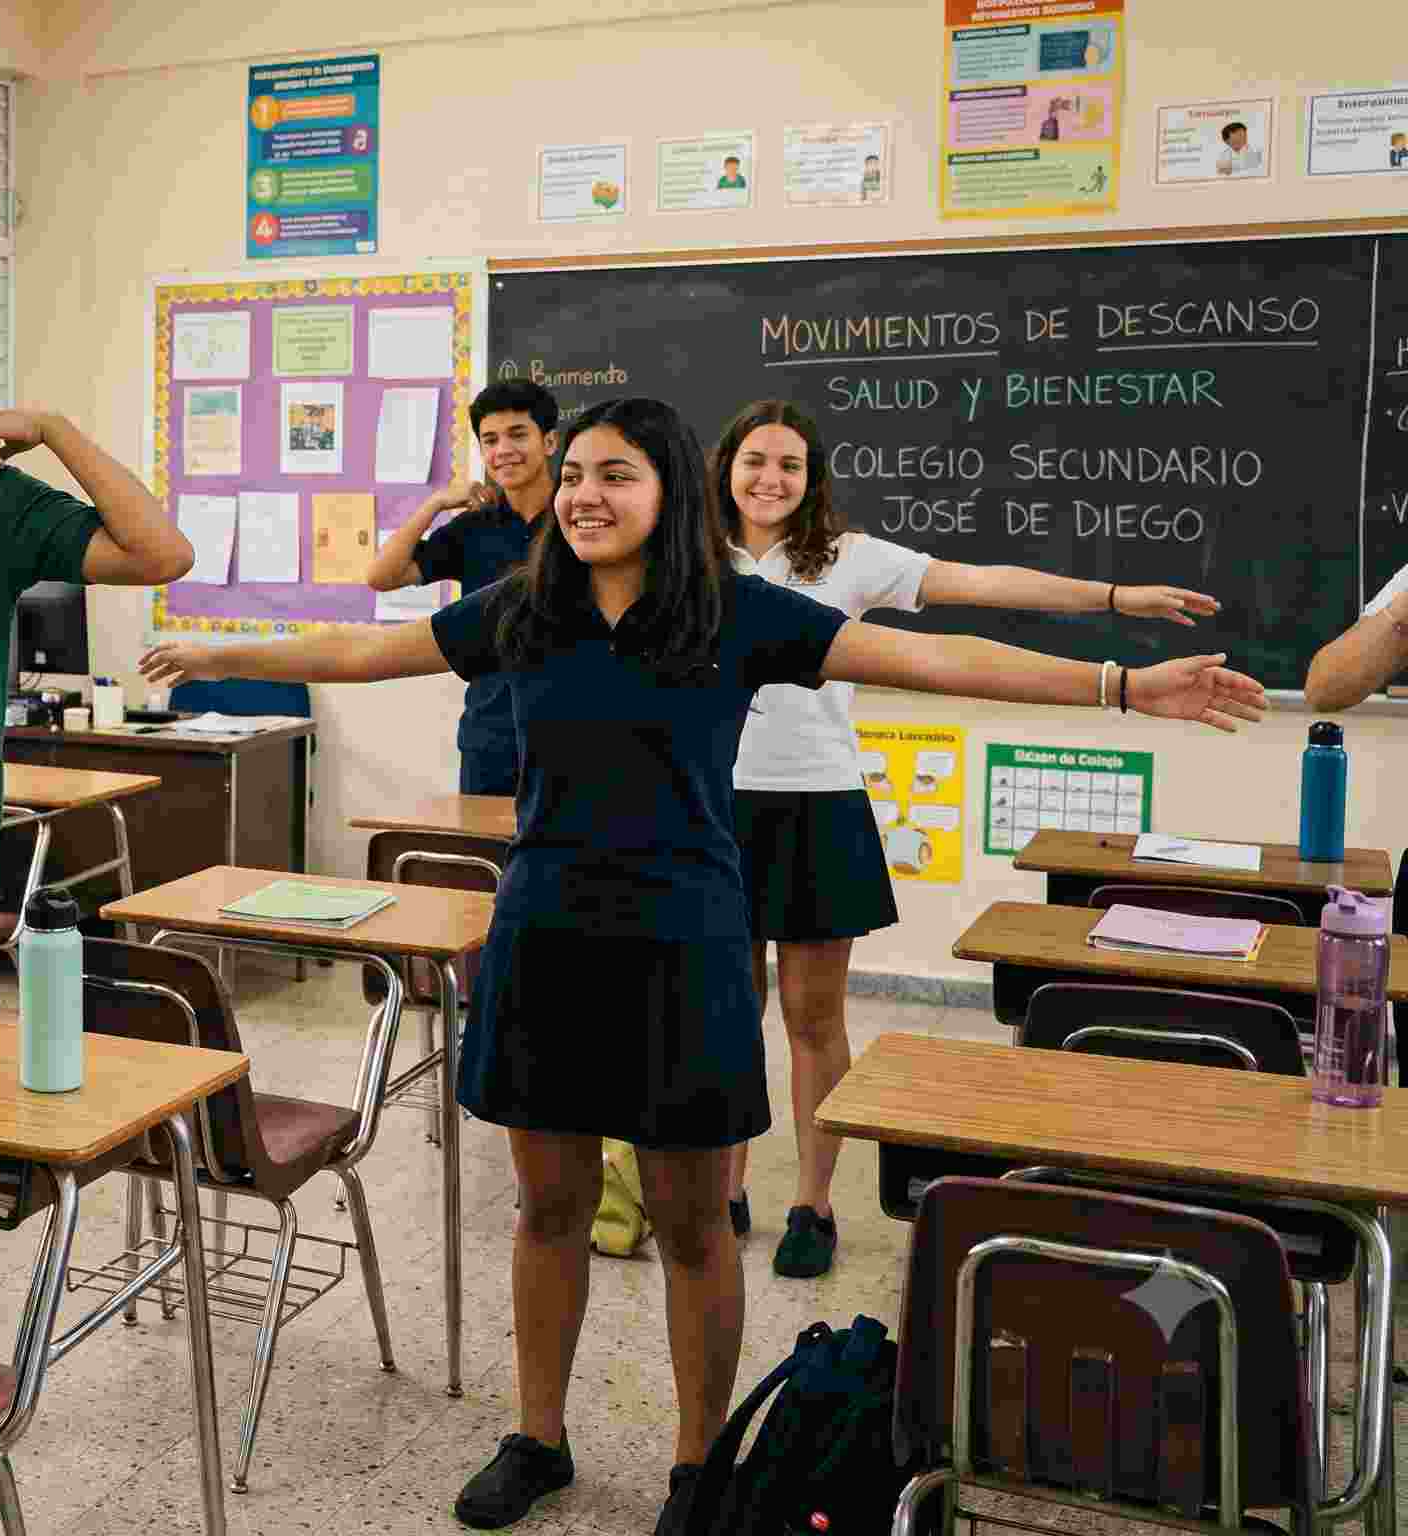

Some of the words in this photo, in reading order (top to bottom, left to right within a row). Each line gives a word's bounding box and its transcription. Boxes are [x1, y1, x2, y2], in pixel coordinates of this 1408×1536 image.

[255, 217, 273, 238] 4
[760, 312, 1001, 356] MOVIMIENTOS
[1025, 307, 1071, 342] DE
[1096, 296, 1320, 339] DESCANSO
[827, 375, 940, 411] SALUD
[1005, 369, 1225, 409] BIENESTAR
[830, 441, 985, 481] COLEGIO
[1008, 443, 1263, 487] SECUNDARIO
[880, 486, 983, 534] JOSÉ
[1004, 500, 1051, 536] DE
[1071, 499, 1205, 543] DIEGO
